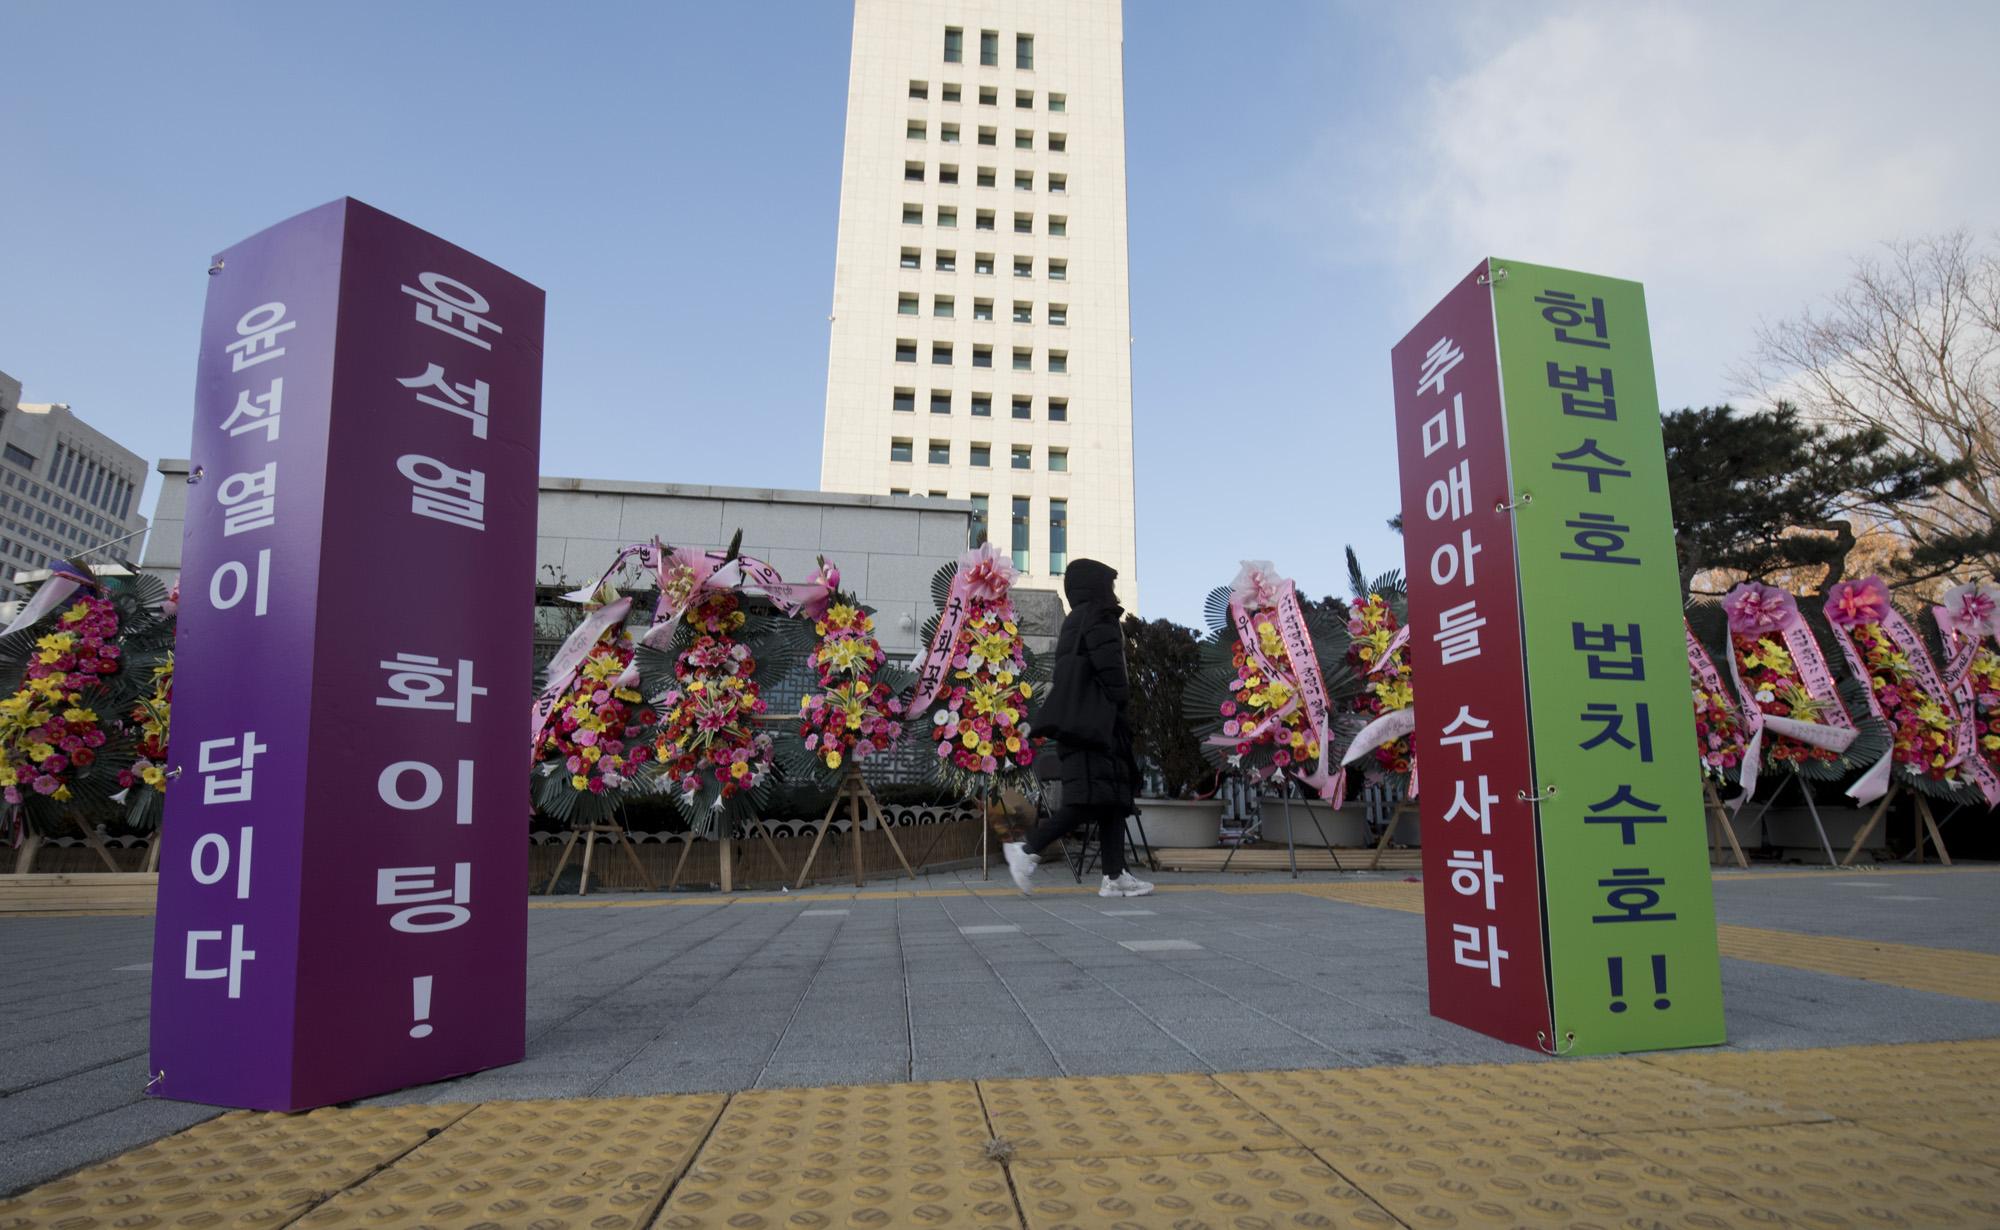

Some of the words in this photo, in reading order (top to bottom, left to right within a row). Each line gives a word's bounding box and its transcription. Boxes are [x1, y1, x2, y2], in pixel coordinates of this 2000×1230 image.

[211, 301, 296, 616] 윤석열이
[396, 271, 503, 531] 윤석열
[1416, 336, 1488, 666] 추미애아들
[1534, 289, 1642, 566] 헌법수호
[185, 732, 267, 999] 답이다
[376, 652, 488, 1038] 화이팅!
[1439, 705, 1509, 988] 수사하라
[1572, 621, 1677, 1014] 법치수호!!
